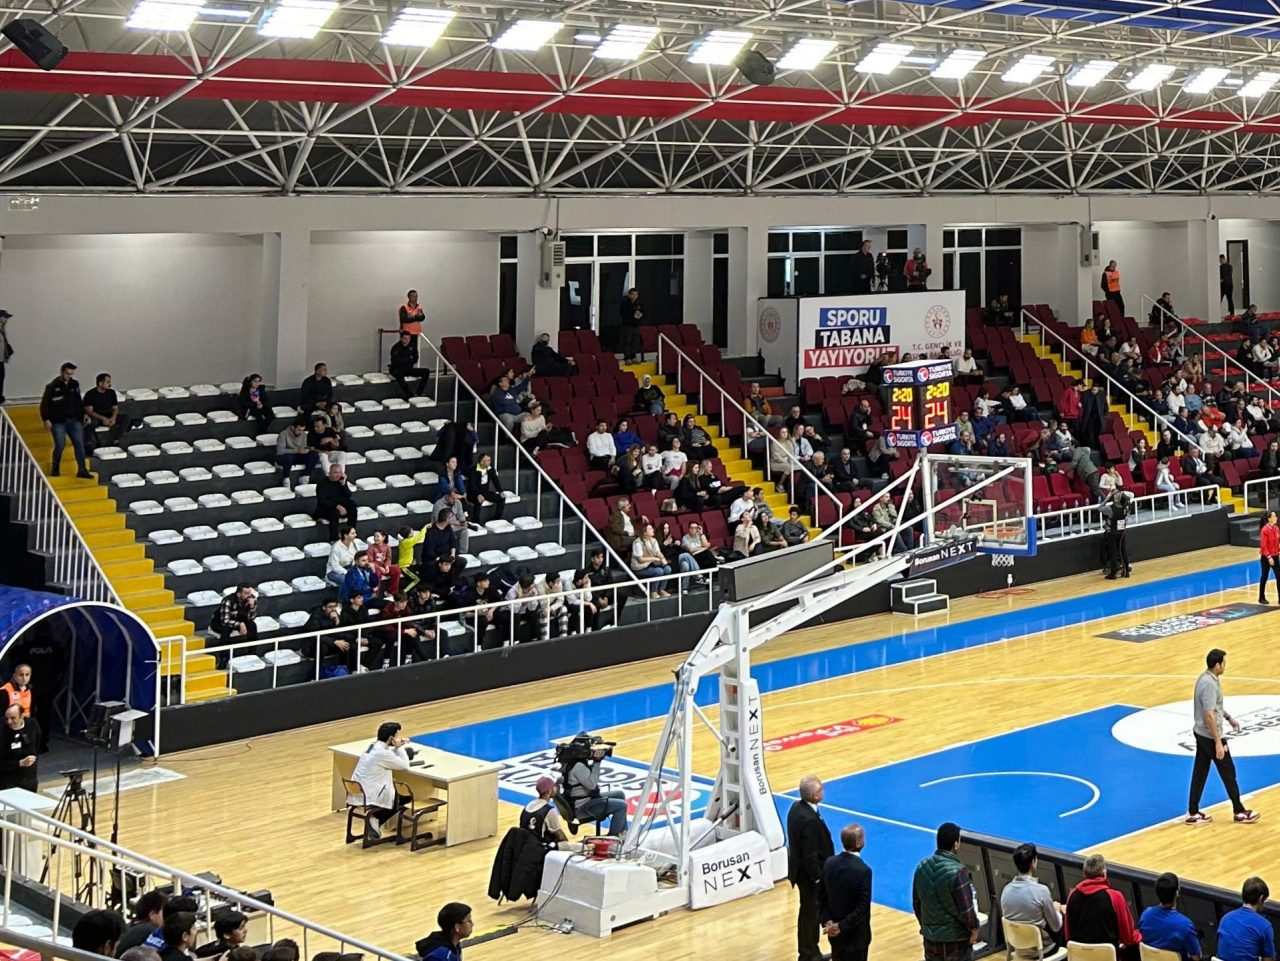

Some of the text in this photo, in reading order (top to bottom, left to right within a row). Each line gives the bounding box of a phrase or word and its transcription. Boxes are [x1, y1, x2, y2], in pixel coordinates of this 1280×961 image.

[826, 309, 881, 327] SPORU
[820, 326, 885, 348] TABANA
[954, 340, 962, 348] VE
[892, 387, 913, 402] 2:20
[926, 382, 950, 400] 2:20
[891, 405, 912, 430] 24
[924, 400, 949, 429] 24
[915, 542, 973, 565] Borusan NEXT
[749, 696, 767, 795] NEXT Borusan
[702, 851, 750, 875] Borusan
[704, 860, 766, 894] NEXT
